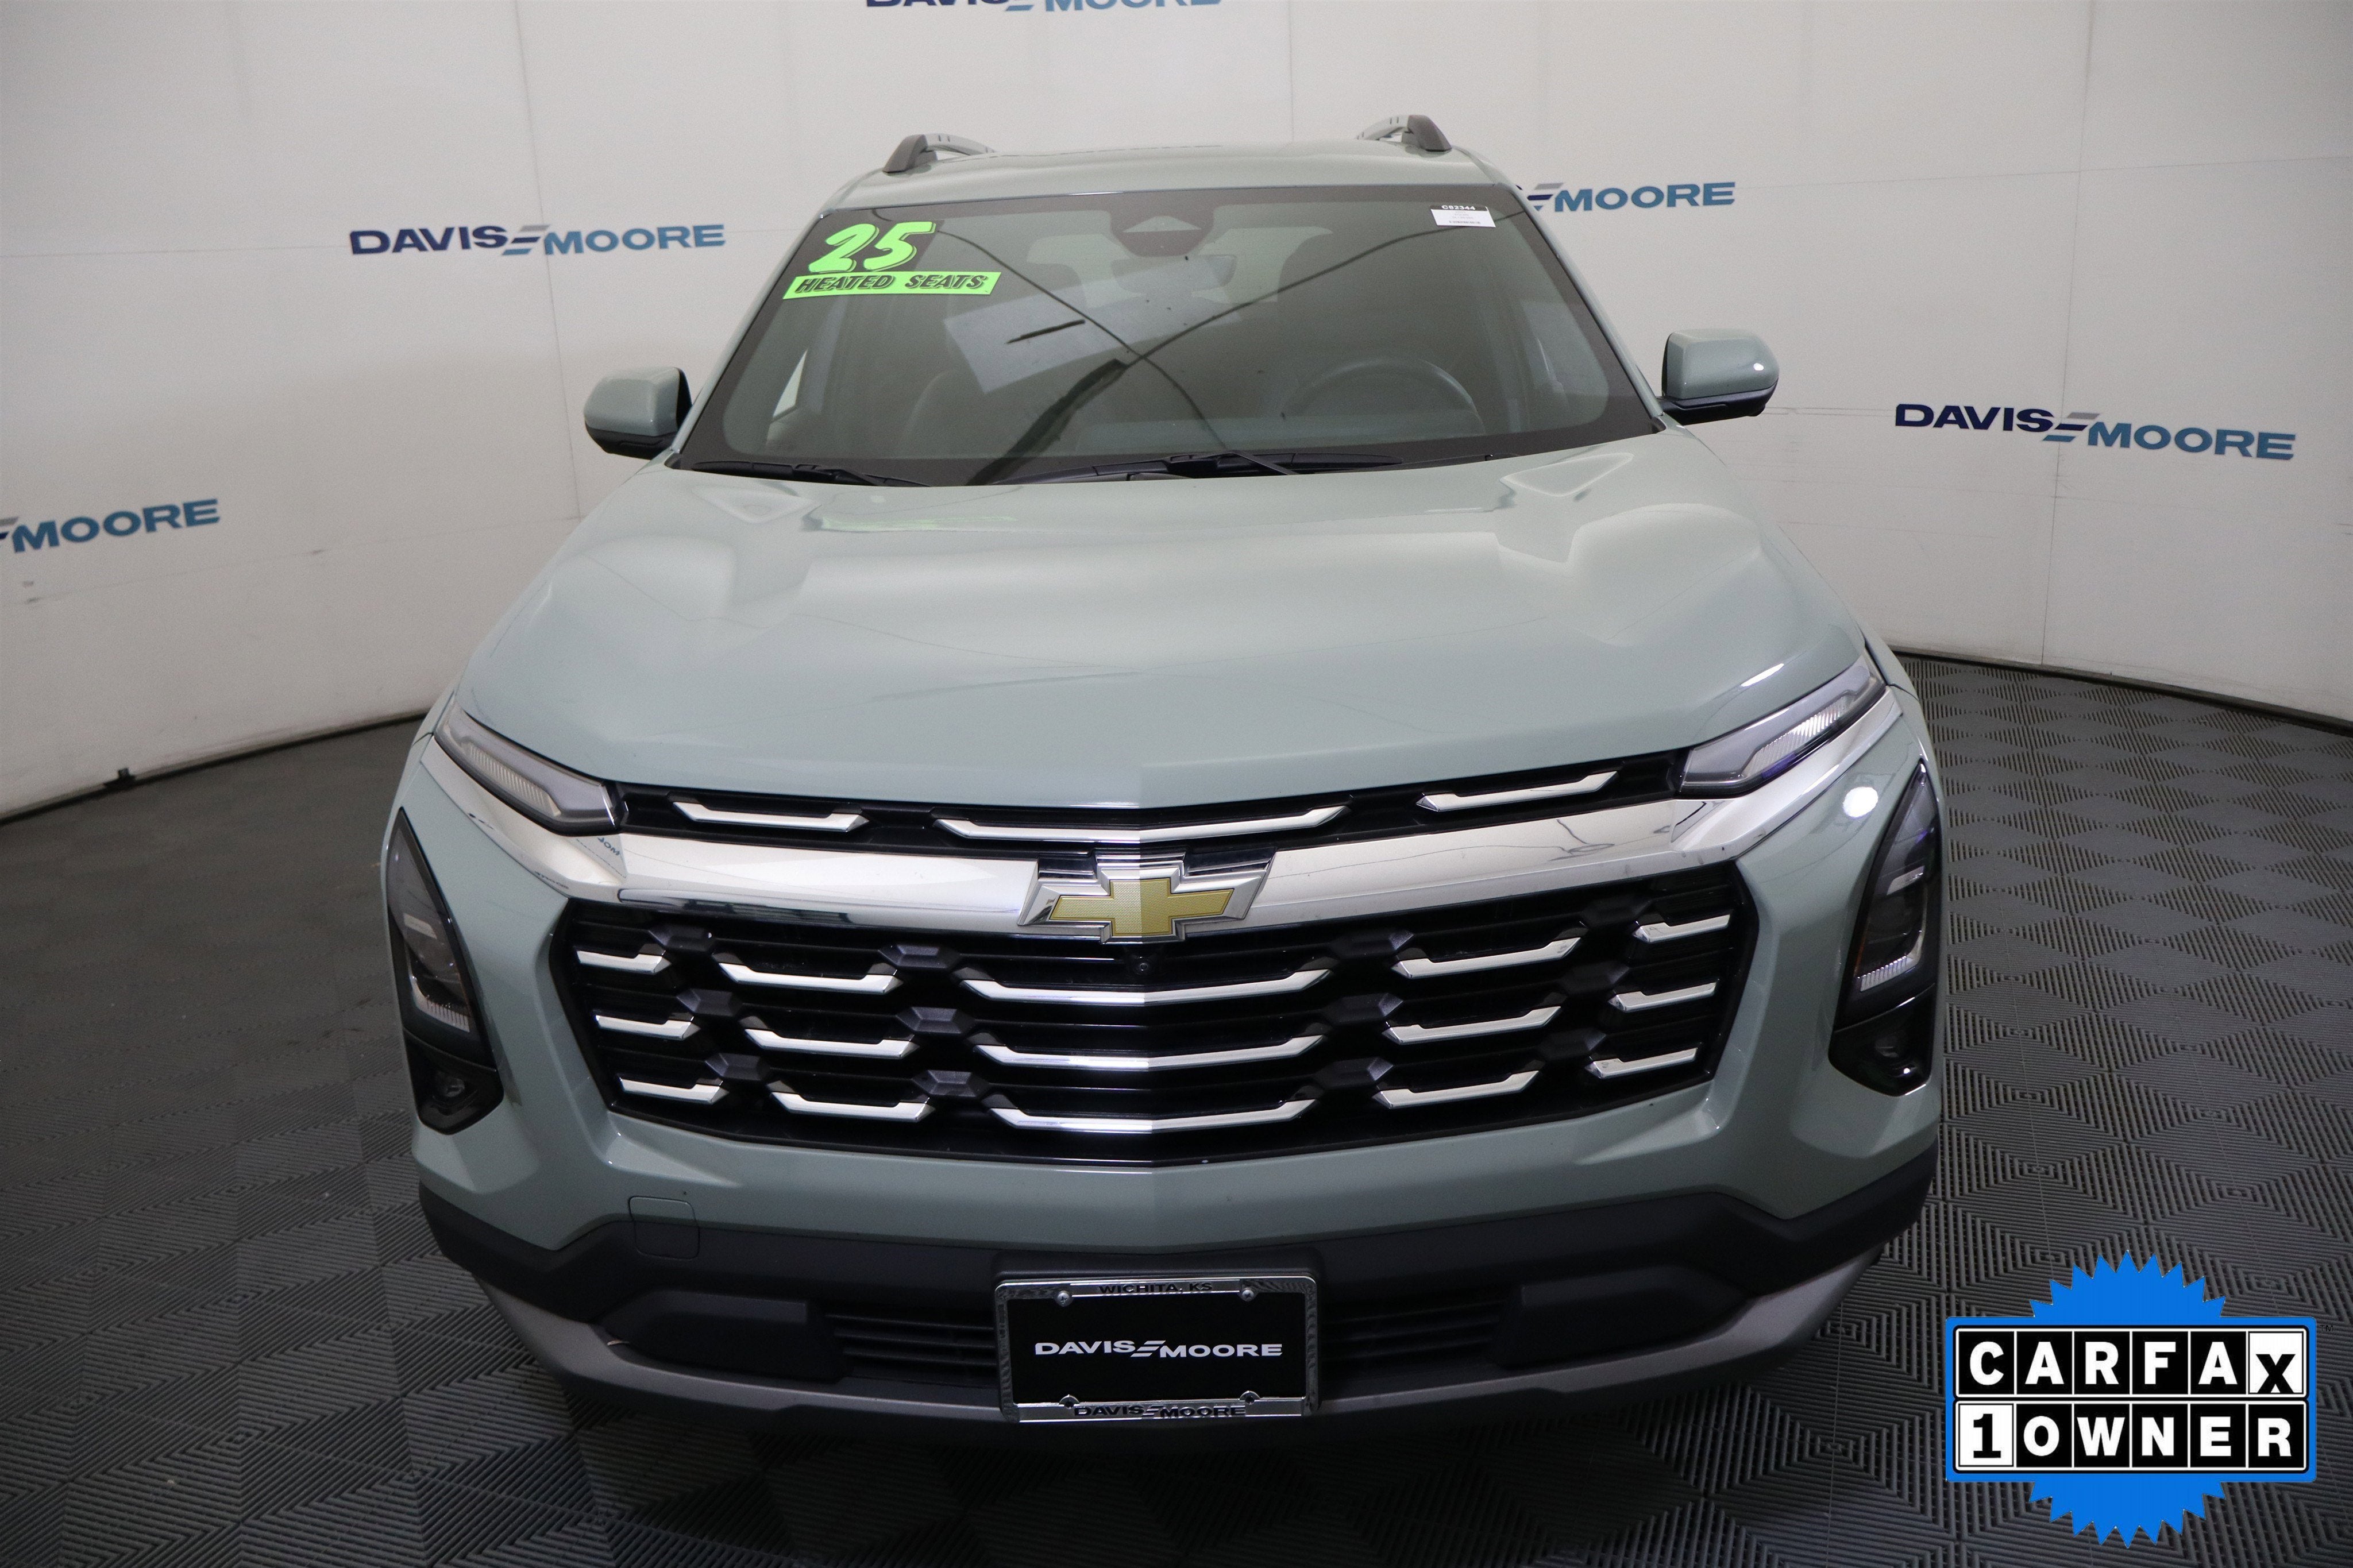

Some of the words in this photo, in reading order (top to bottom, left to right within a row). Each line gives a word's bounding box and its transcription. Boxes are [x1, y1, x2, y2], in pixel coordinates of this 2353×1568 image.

[1554, 182, 1735, 212] MOORE
[349, 226, 508, 254] DAVIS
[543, 225, 726, 255] MOORE
[808, 221, 936, 273] 25
[795, 275, 896, 293] HEATED
[905, 275, 988, 289] SEATS
[1895, 404, 2055, 432] DAVIS
[2086, 422, 2296, 460] MOORE
[11, 499, 221, 553] MOORE
[1189, 1282, 1213, 1291] KS
[1035, 1340, 1136, 1355] DAVIS
[1159, 1343, 1283, 1358] MOORE
[1074, 1405, 1144, 1416] DAVIS
[1160, 1405, 1246, 1418] MOORE
